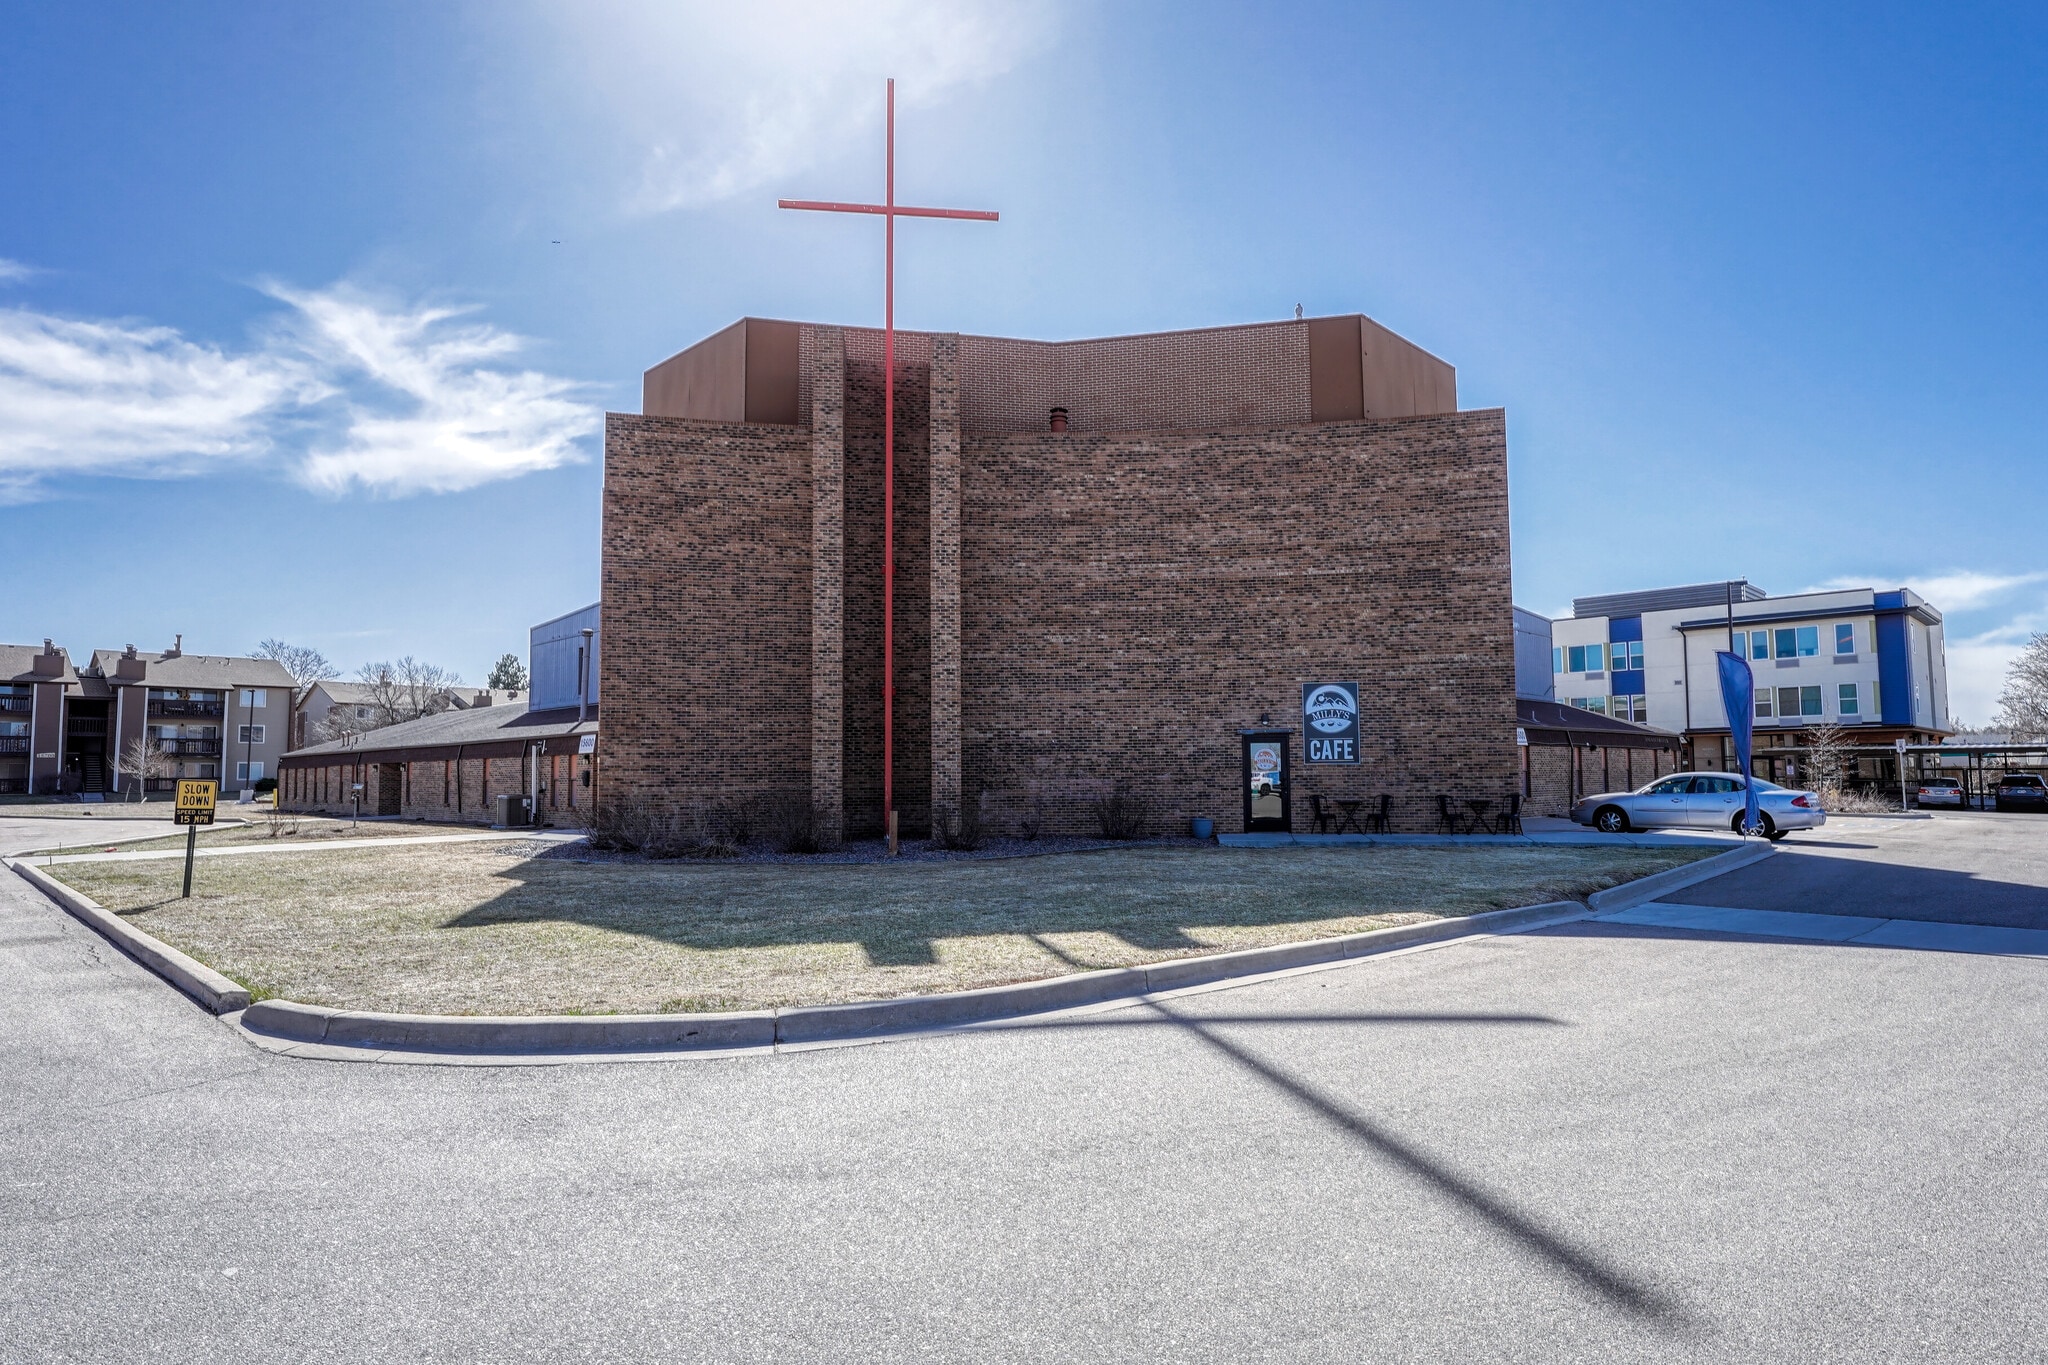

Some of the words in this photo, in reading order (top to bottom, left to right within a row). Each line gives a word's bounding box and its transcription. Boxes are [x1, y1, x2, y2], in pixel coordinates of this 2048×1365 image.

[1312, 709, 1350, 720] MILLY'S
[1310, 739, 1354, 760] CAFE
[184, 784, 210, 794] SLOW
[182, 796, 210, 806] DOWN
[180, 816, 190, 824] 15
[194, 816, 208, 824] MPH
